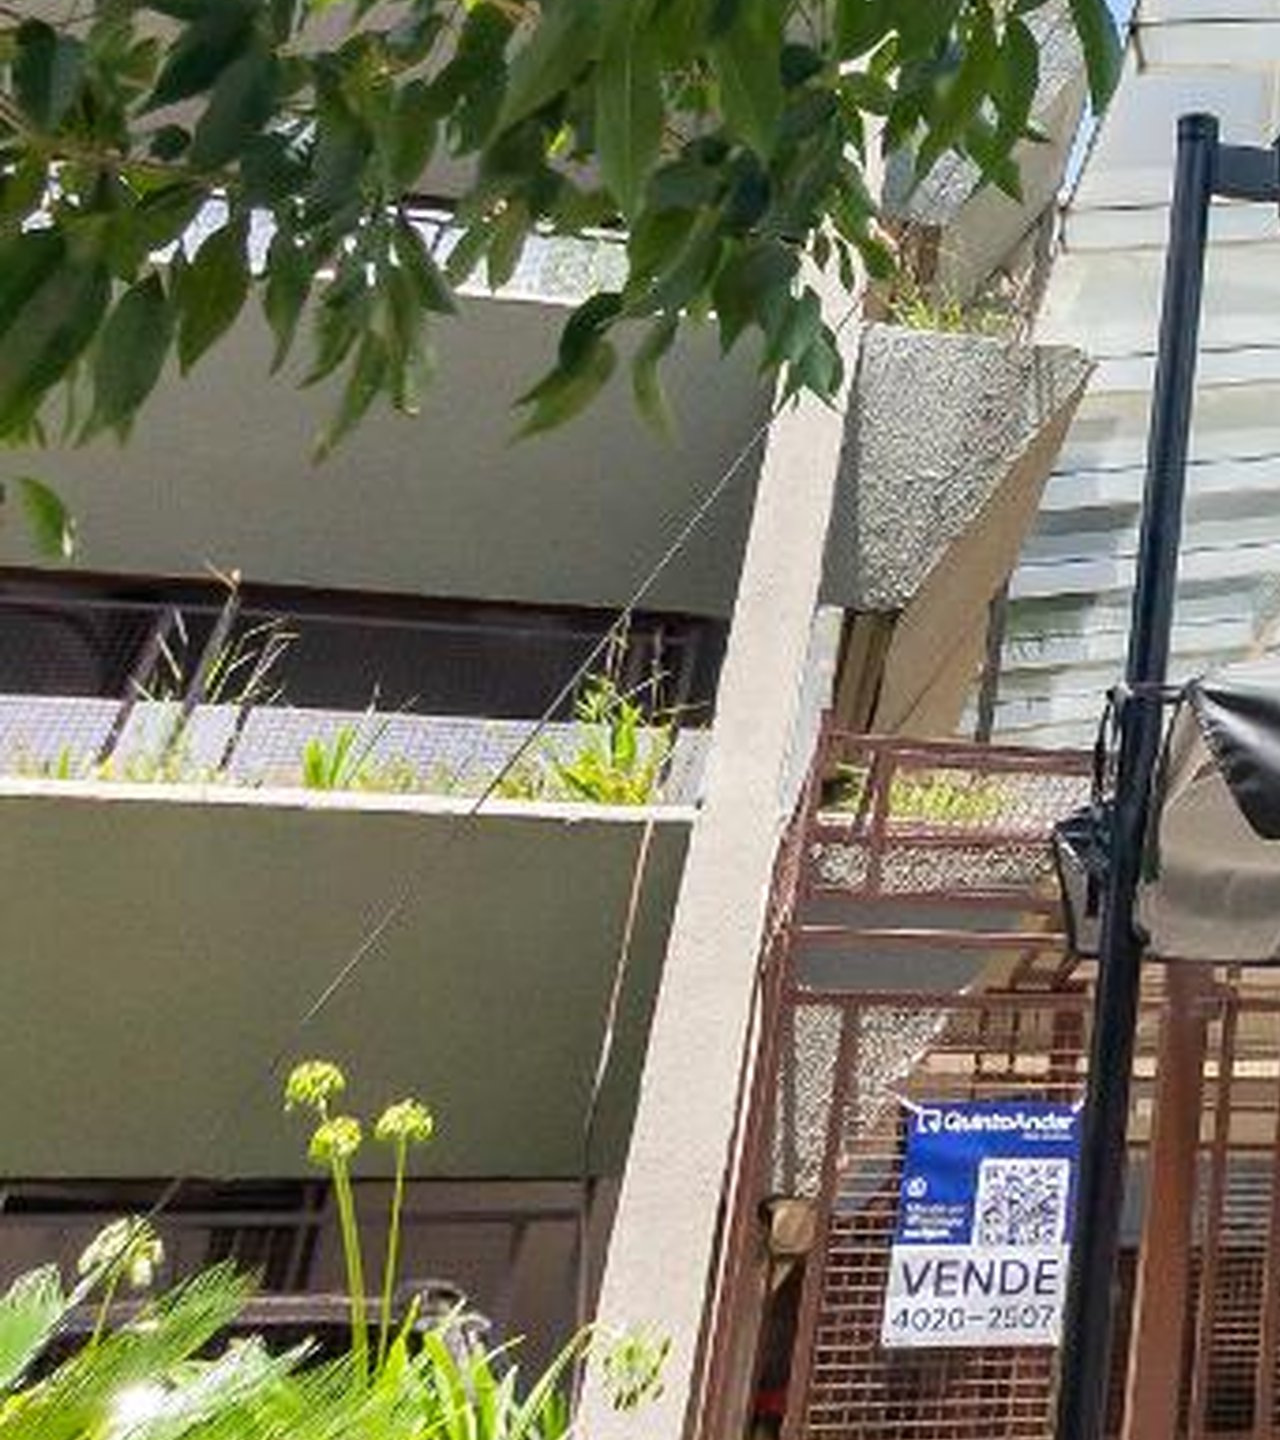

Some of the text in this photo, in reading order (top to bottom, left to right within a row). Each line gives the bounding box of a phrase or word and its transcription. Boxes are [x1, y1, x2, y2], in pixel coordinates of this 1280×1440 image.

[944, 1111, 1074, 1133] QuintoAndar
[902, 1259, 1060, 1297] VENDE
[891, 1304, 1055, 1332] 4020-2507
